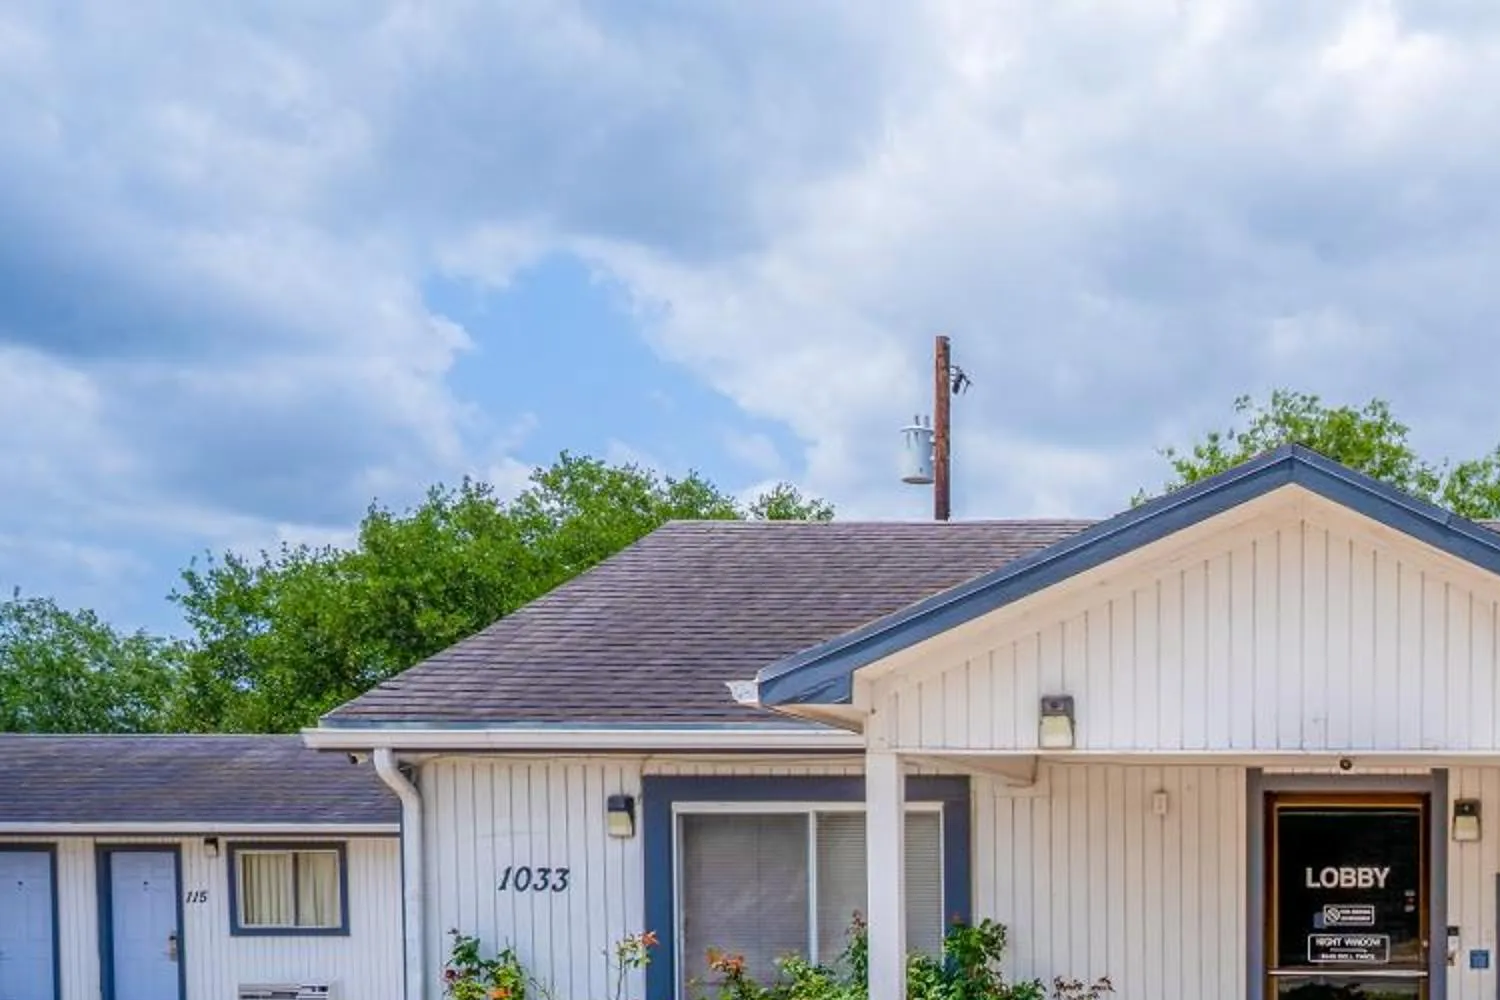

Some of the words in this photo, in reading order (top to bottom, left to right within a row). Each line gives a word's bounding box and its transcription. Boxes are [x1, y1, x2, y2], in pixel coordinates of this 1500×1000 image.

[498, 866, 570, 892] 1033
[1305, 867, 1390, 888] LOBBY
[186, 891, 208, 903] 115
